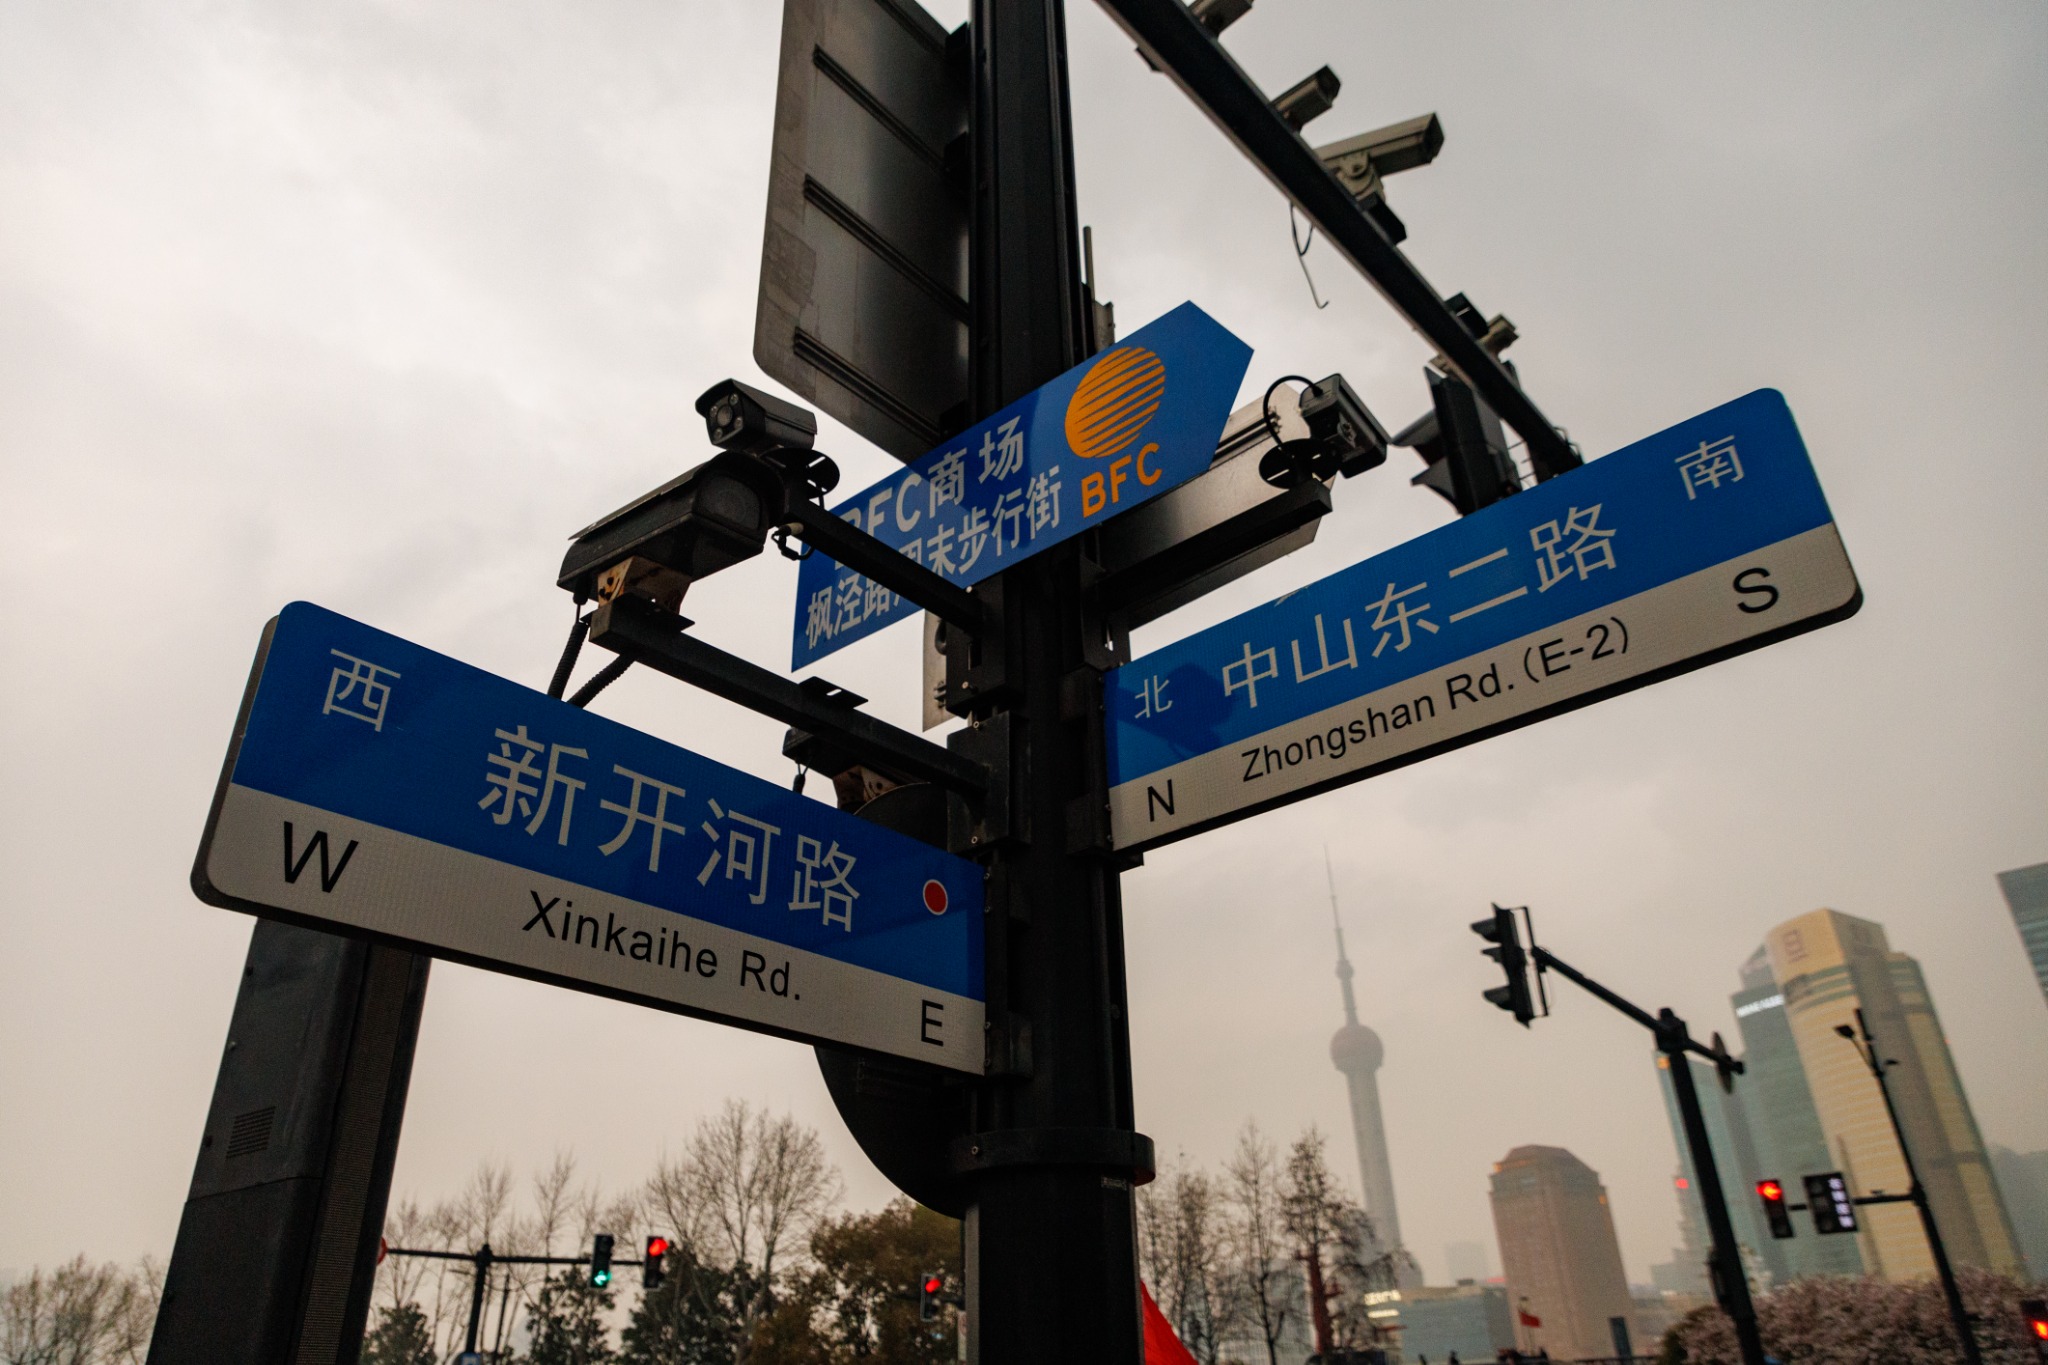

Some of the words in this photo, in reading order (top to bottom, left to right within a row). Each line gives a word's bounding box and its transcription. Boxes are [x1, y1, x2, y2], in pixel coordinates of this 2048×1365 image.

[1080, 443, 1163, 518] BFC
[1675, 434, 1744, 501] 南
[1221, 502, 1618, 710] 中山东二路
[1732, 567, 1779, 614] S
[322, 648, 401, 732] 西
[1133, 675, 1174, 722] 北
[1241, 694, 1436, 782] Zhongshan
[1447, 665, 1515, 712] Rd.
[477, 725, 860, 932] 新开河路
[1147, 779, 1176, 822] N
[282, 820, 358, 893] W
[522, 890, 718, 978] Xinkaihe
[740, 950, 800, 1000] Rd.
[920, 999, 944, 1047] E
